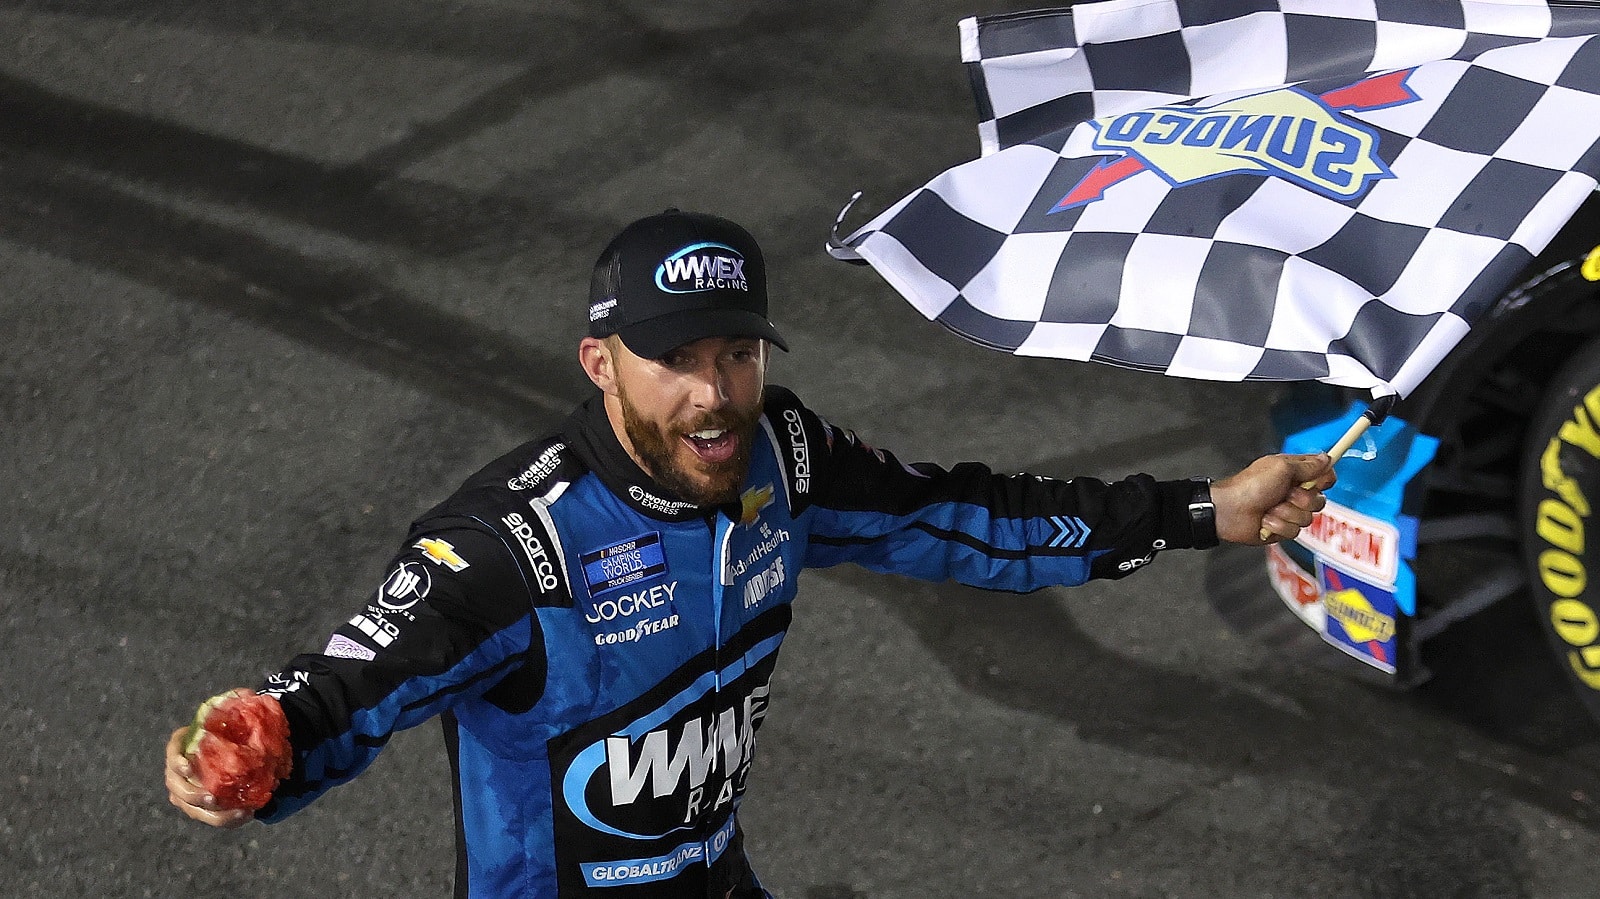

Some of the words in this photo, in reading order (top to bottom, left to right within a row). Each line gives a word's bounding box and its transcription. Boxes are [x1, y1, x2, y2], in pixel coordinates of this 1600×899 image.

[695, 277, 748, 292] RACING
[783, 409, 810, 494] sparco
[641, 498, 680, 516] EXPRESS
[502, 512, 558, 593] sparco
[609, 541, 636, 556] NASCAR
[1306, 512, 1385, 568] MPSON
[1535, 382, 1600, 690] GOODY
[601, 550, 641, 569] CAMPING
[607, 576, 625, 588] TRUCK
[625, 571, 644, 584] SERIES
[744, 556, 786, 609] MOOSE
[585, 581, 678, 624] JOCKEY
[595, 614, 680, 646] GOODYEAR
[592, 847, 703, 881] GLOBALTRANZ
